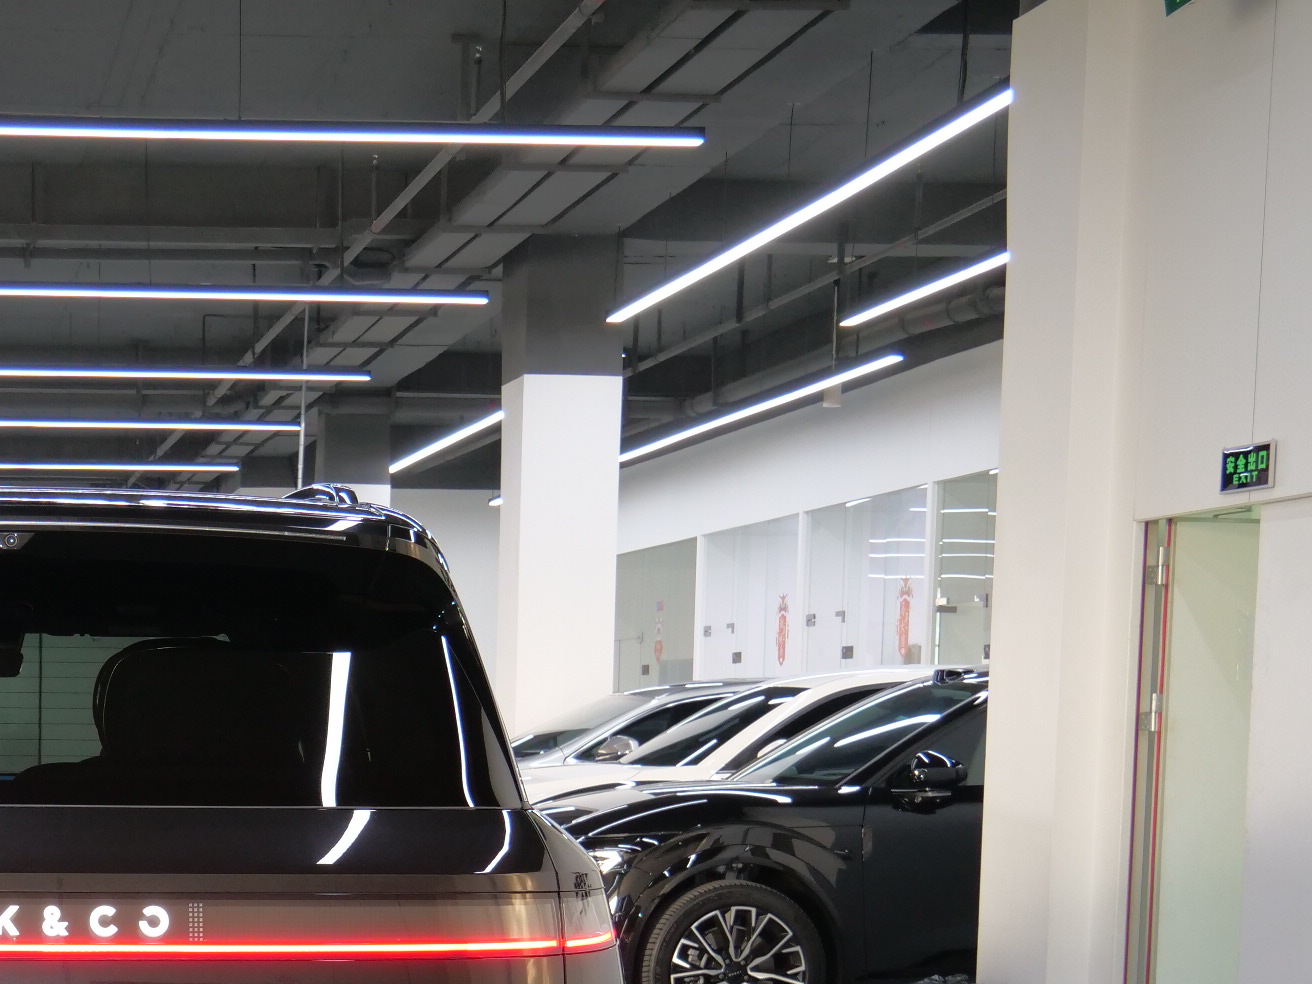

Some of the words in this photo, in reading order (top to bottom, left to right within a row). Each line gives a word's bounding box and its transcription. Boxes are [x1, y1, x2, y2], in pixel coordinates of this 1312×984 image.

[1226, 450, 1267, 474] 安全出口
[1233, 471, 1258, 485] EXIT
